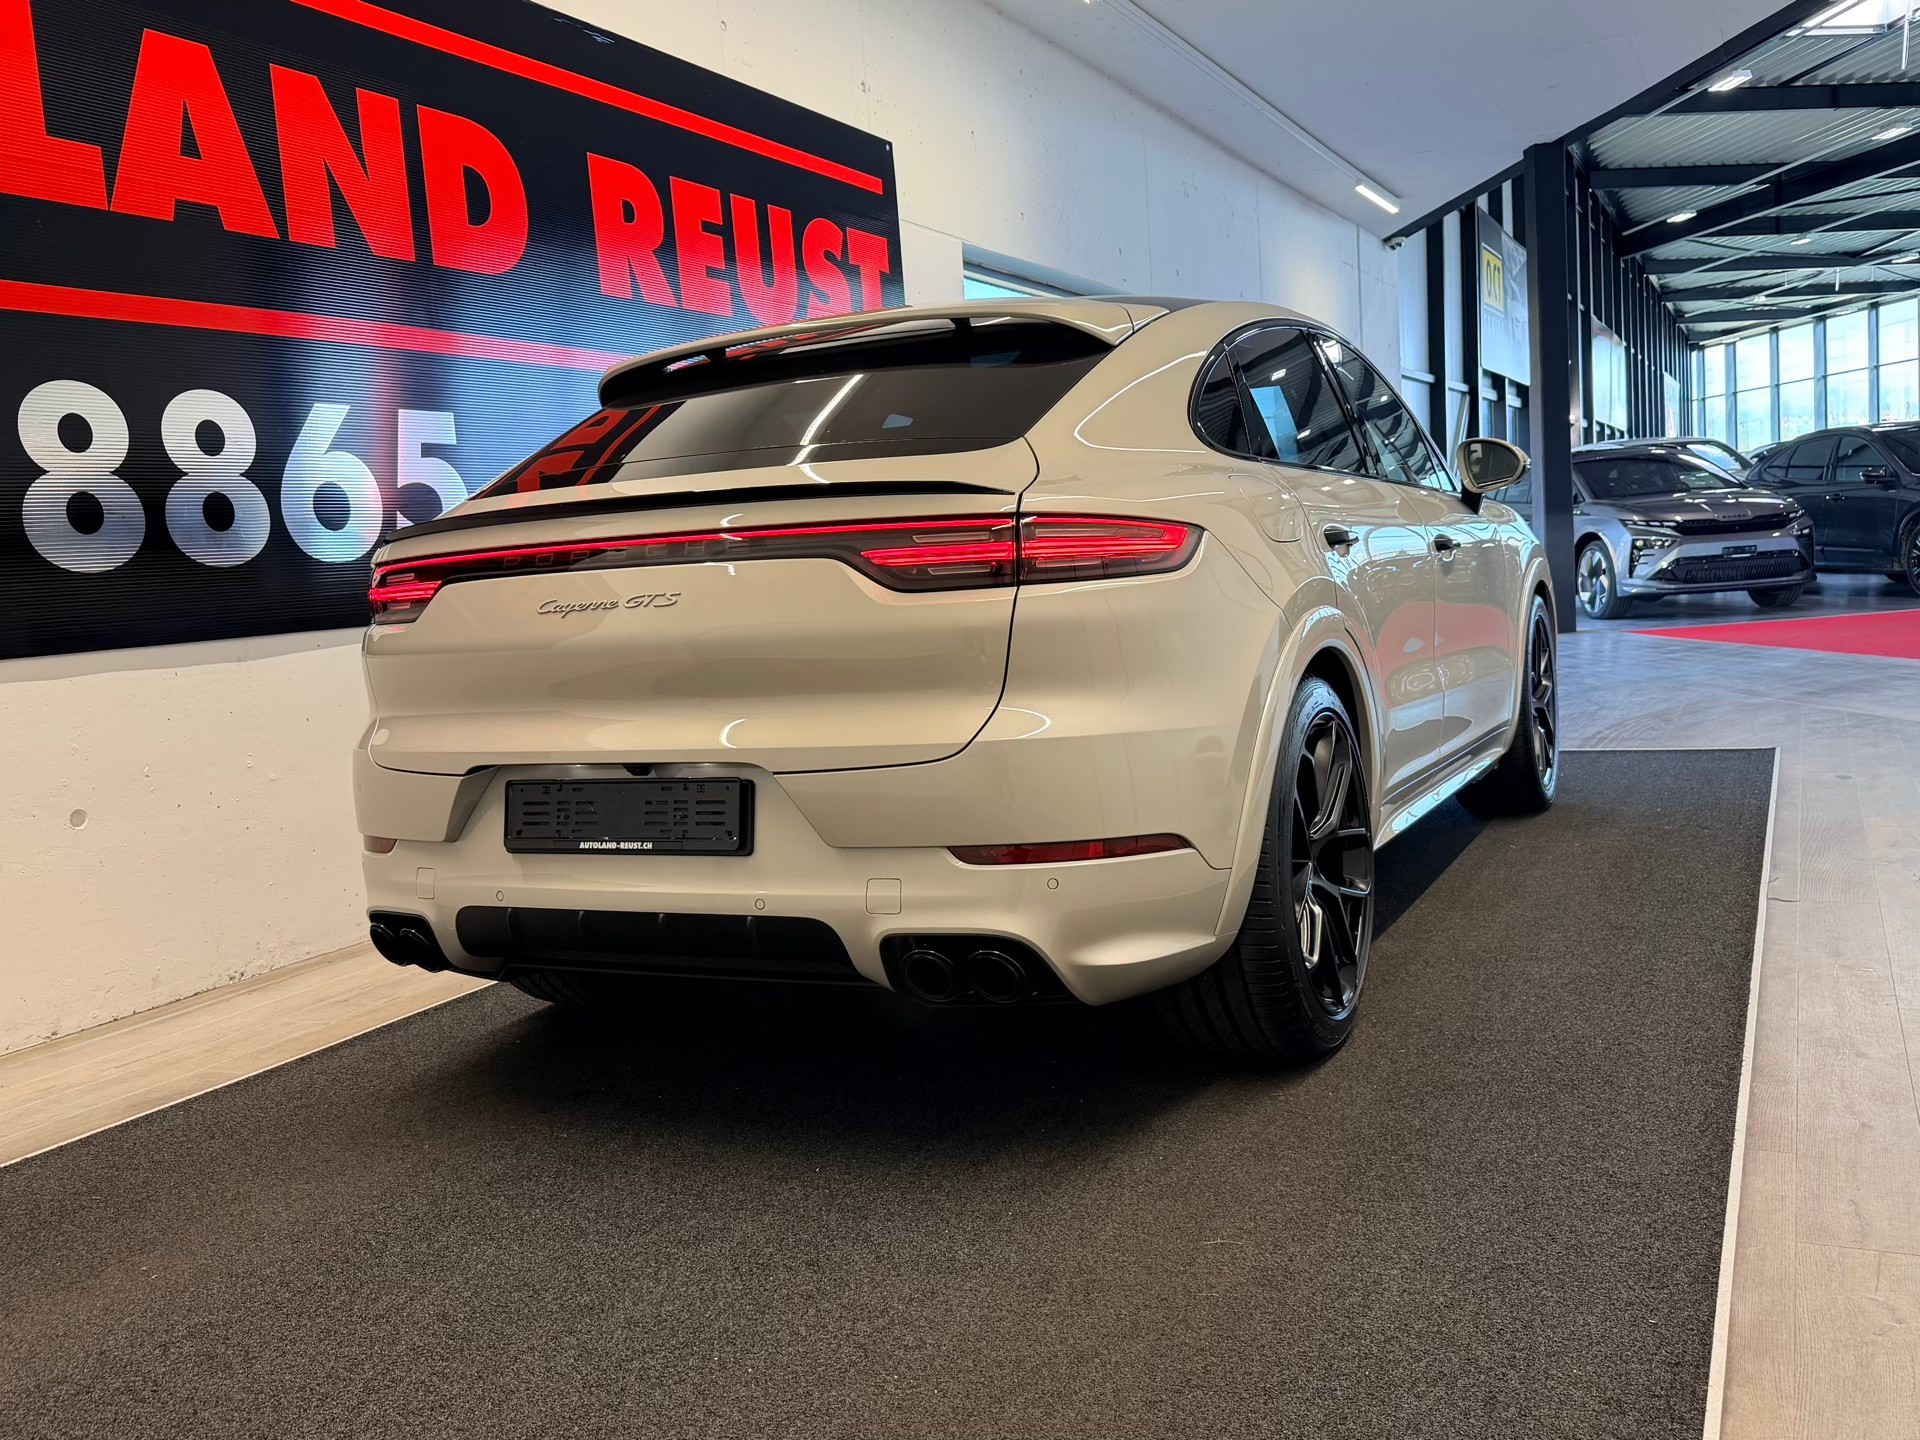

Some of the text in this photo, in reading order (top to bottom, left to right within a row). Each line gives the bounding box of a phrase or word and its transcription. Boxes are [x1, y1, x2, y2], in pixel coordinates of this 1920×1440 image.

[587, 151, 890, 328] REUST
[17, 379, 469, 574] 8865
[502, 539, 751, 569] PORSCHE
[536, 591, 681, 619] Cayenne GTS
[579, 841, 653, 850] AUTOLAND-REUST.CH
